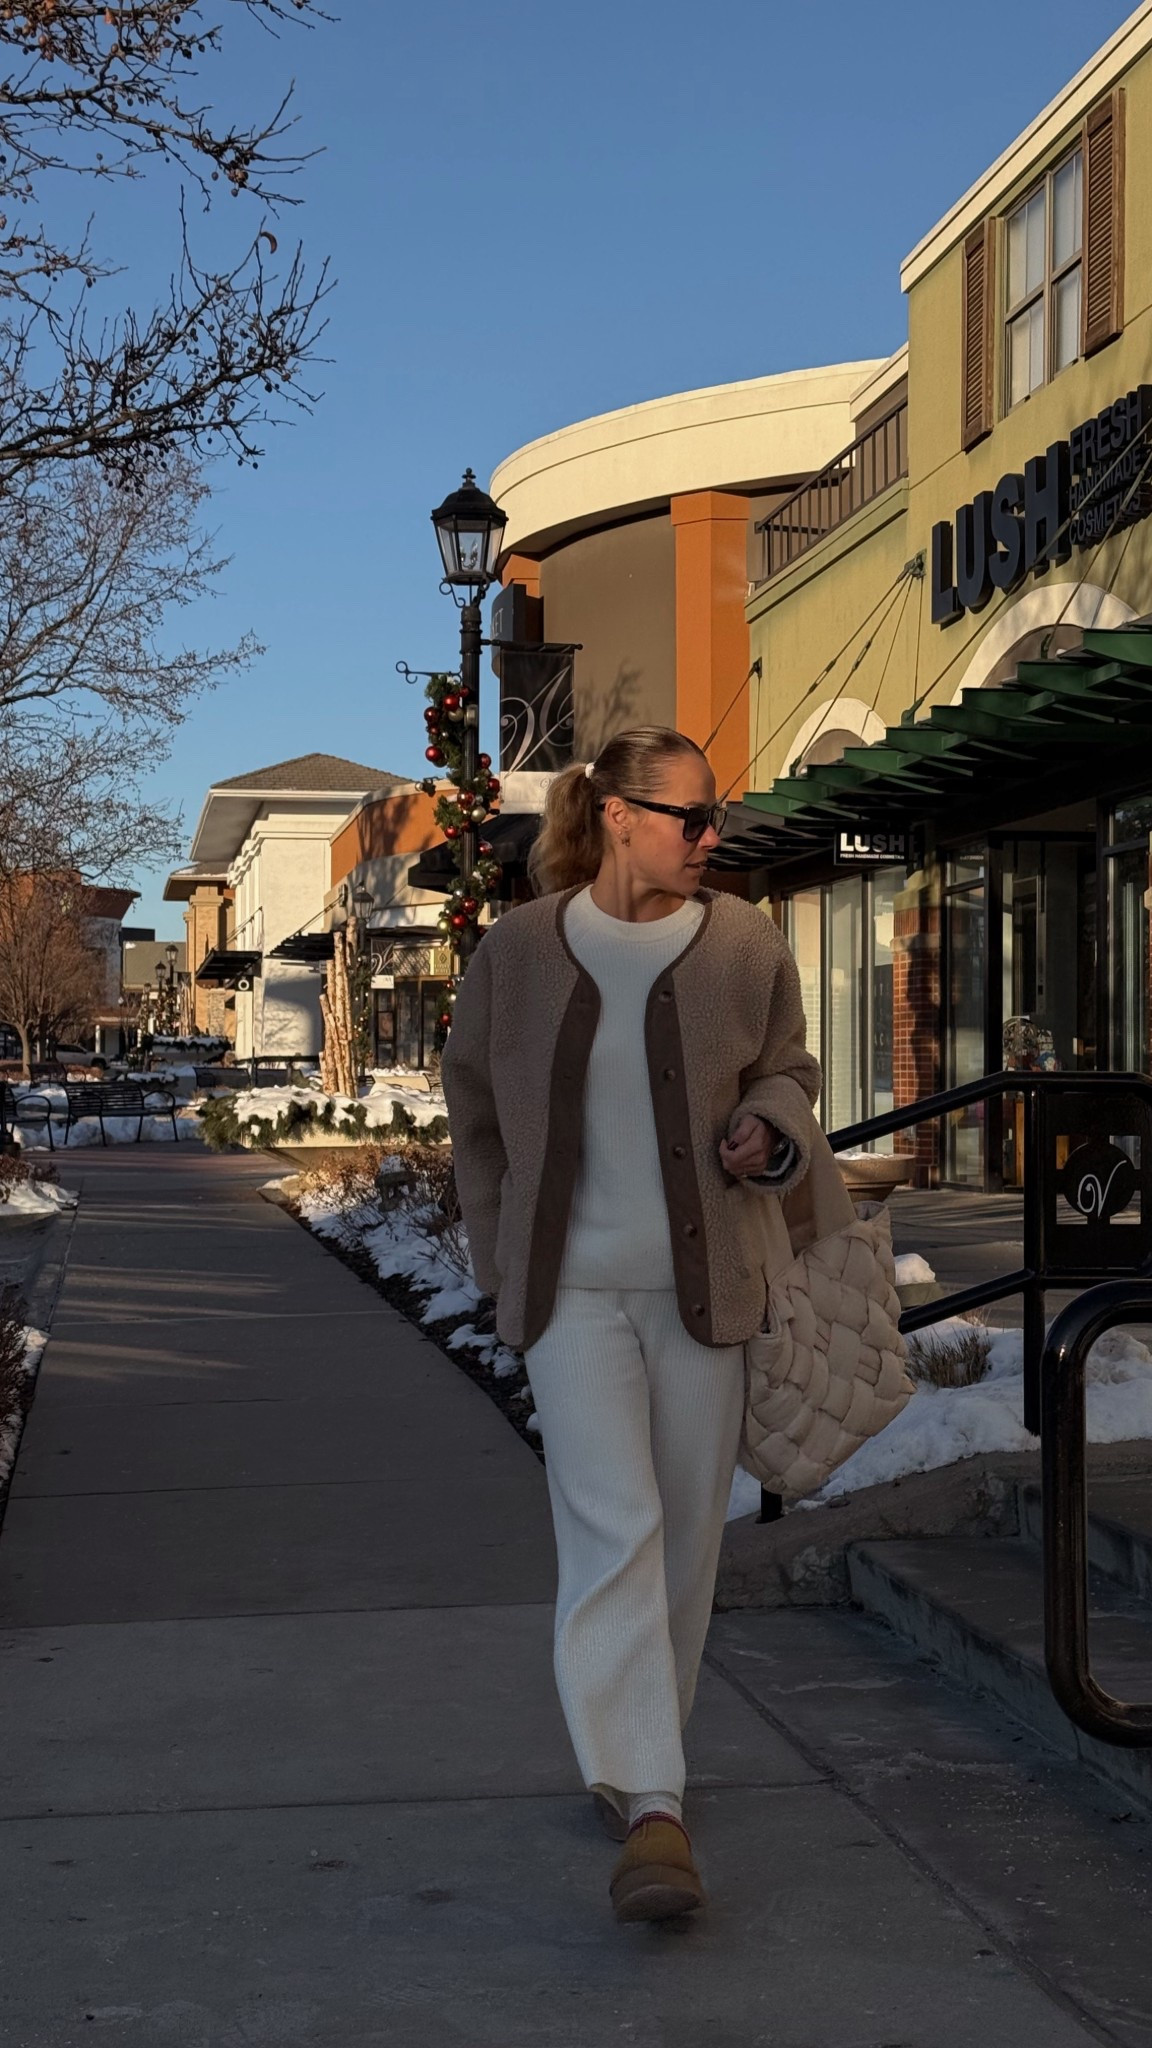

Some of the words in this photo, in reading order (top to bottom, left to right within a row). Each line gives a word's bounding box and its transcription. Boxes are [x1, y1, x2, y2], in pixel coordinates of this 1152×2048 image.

[1069, 391, 1142, 475] FRESH
[932, 441, 1063, 624] LUSH
[840, 832, 905, 853] LUSH
